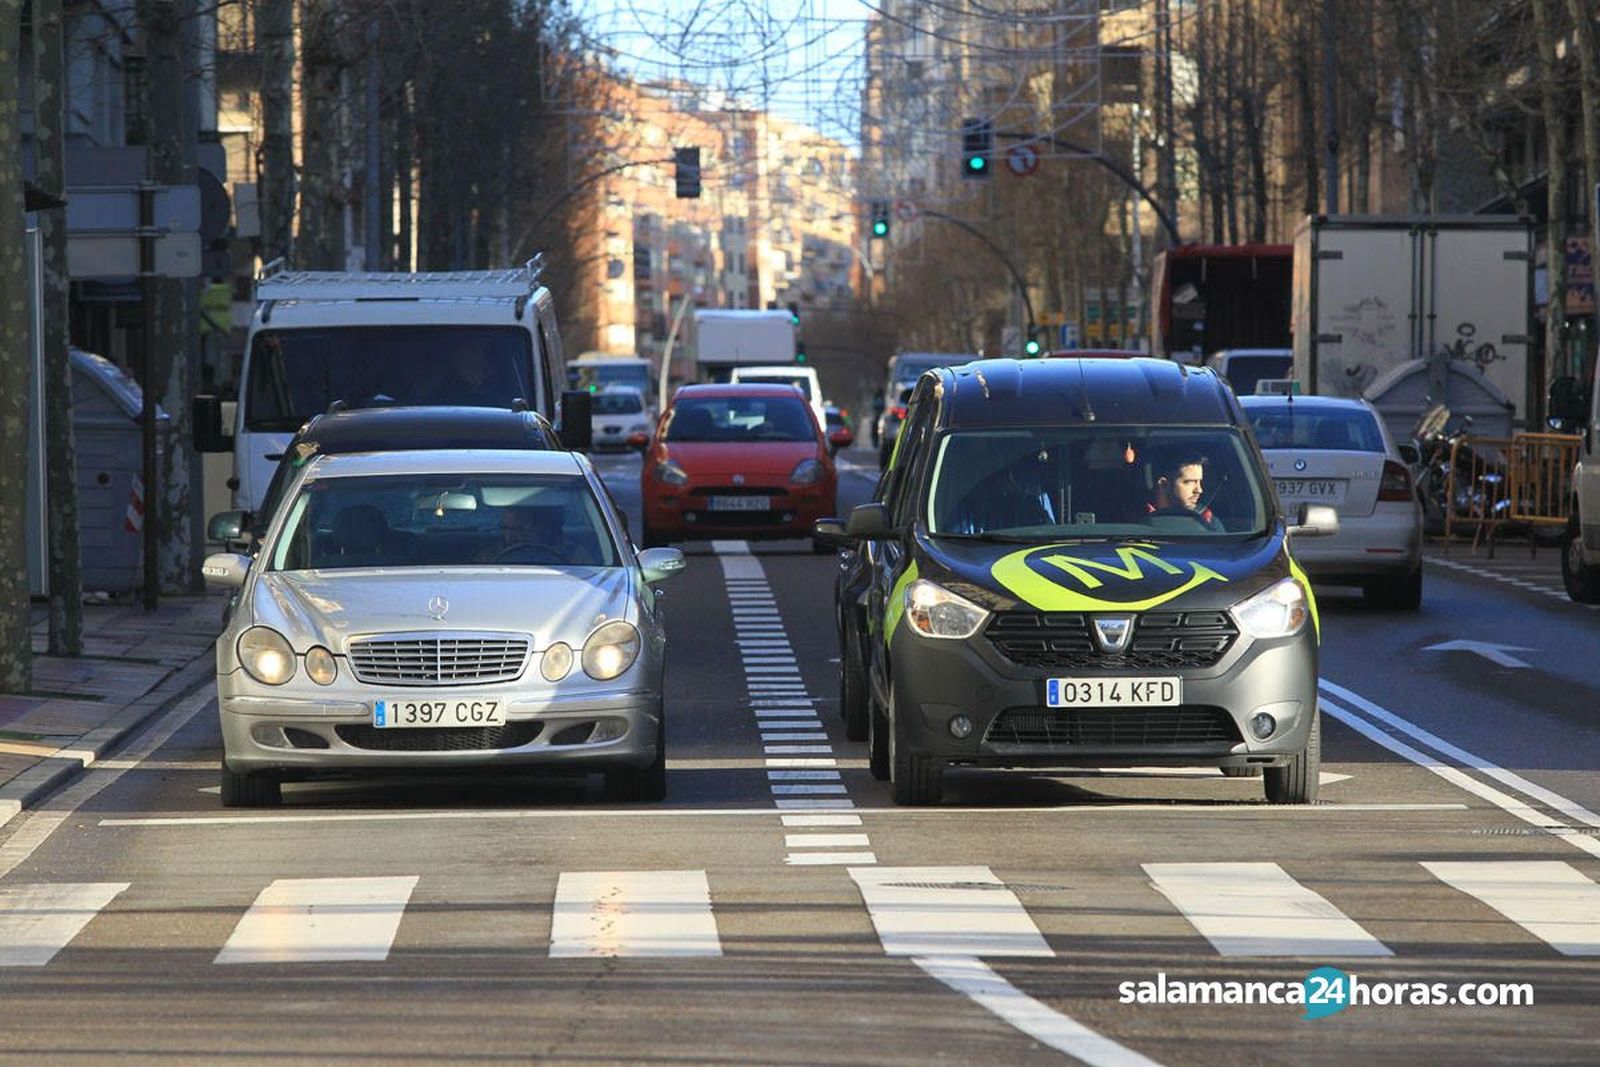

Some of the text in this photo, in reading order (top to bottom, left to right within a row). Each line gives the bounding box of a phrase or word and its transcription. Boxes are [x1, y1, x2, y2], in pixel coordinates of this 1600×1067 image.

[1274, 481, 1337, 495] 937 GVX
[1064, 681, 1174, 703] 0314 KFD
[391, 702, 499, 723] 1397 CGZ
